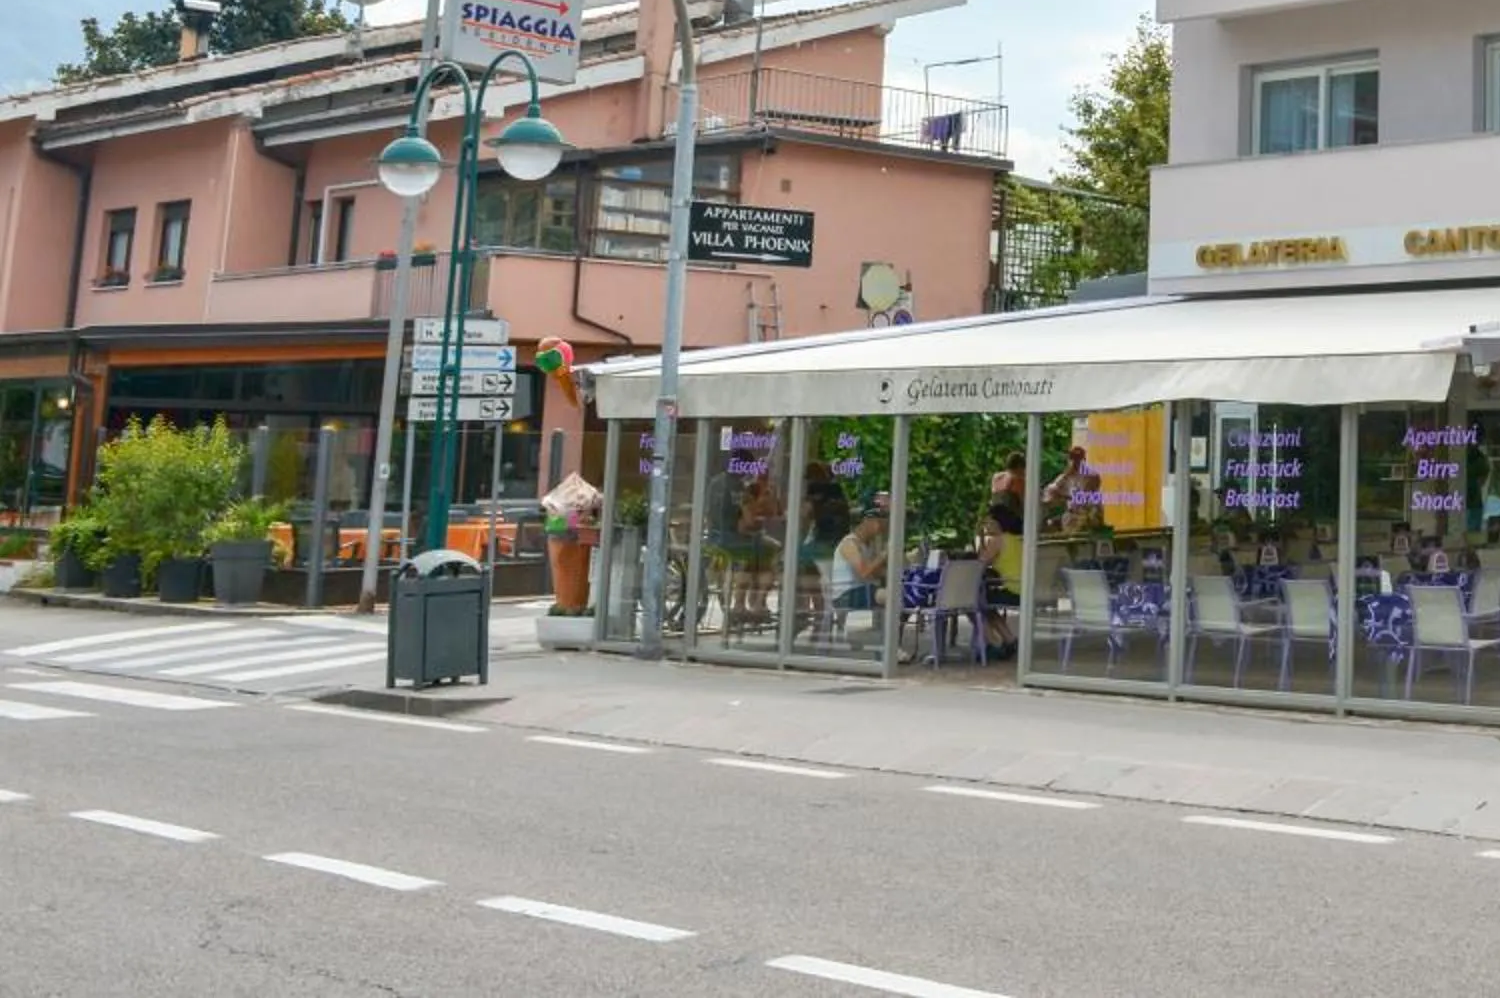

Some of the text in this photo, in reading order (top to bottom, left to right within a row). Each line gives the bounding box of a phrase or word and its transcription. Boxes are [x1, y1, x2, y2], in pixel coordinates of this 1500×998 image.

[462, 2, 576, 41] SPIAGGIA
[704, 206, 804, 225] APPARTAMENTI
[722, 221, 785, 235] PER VACANZE
[692, 231, 811, 253] VILLA PHOENIX
[1196, 236, 1348, 268] GELATERIA
[907, 376, 1054, 406] Gelateria Cantonati
[1402, 423, 1478, 451] Aperitivi
[1417, 459, 1459, 479] Birre
[1225, 488, 1300, 508] Breakfast
[1411, 490, 1464, 512] Snack
